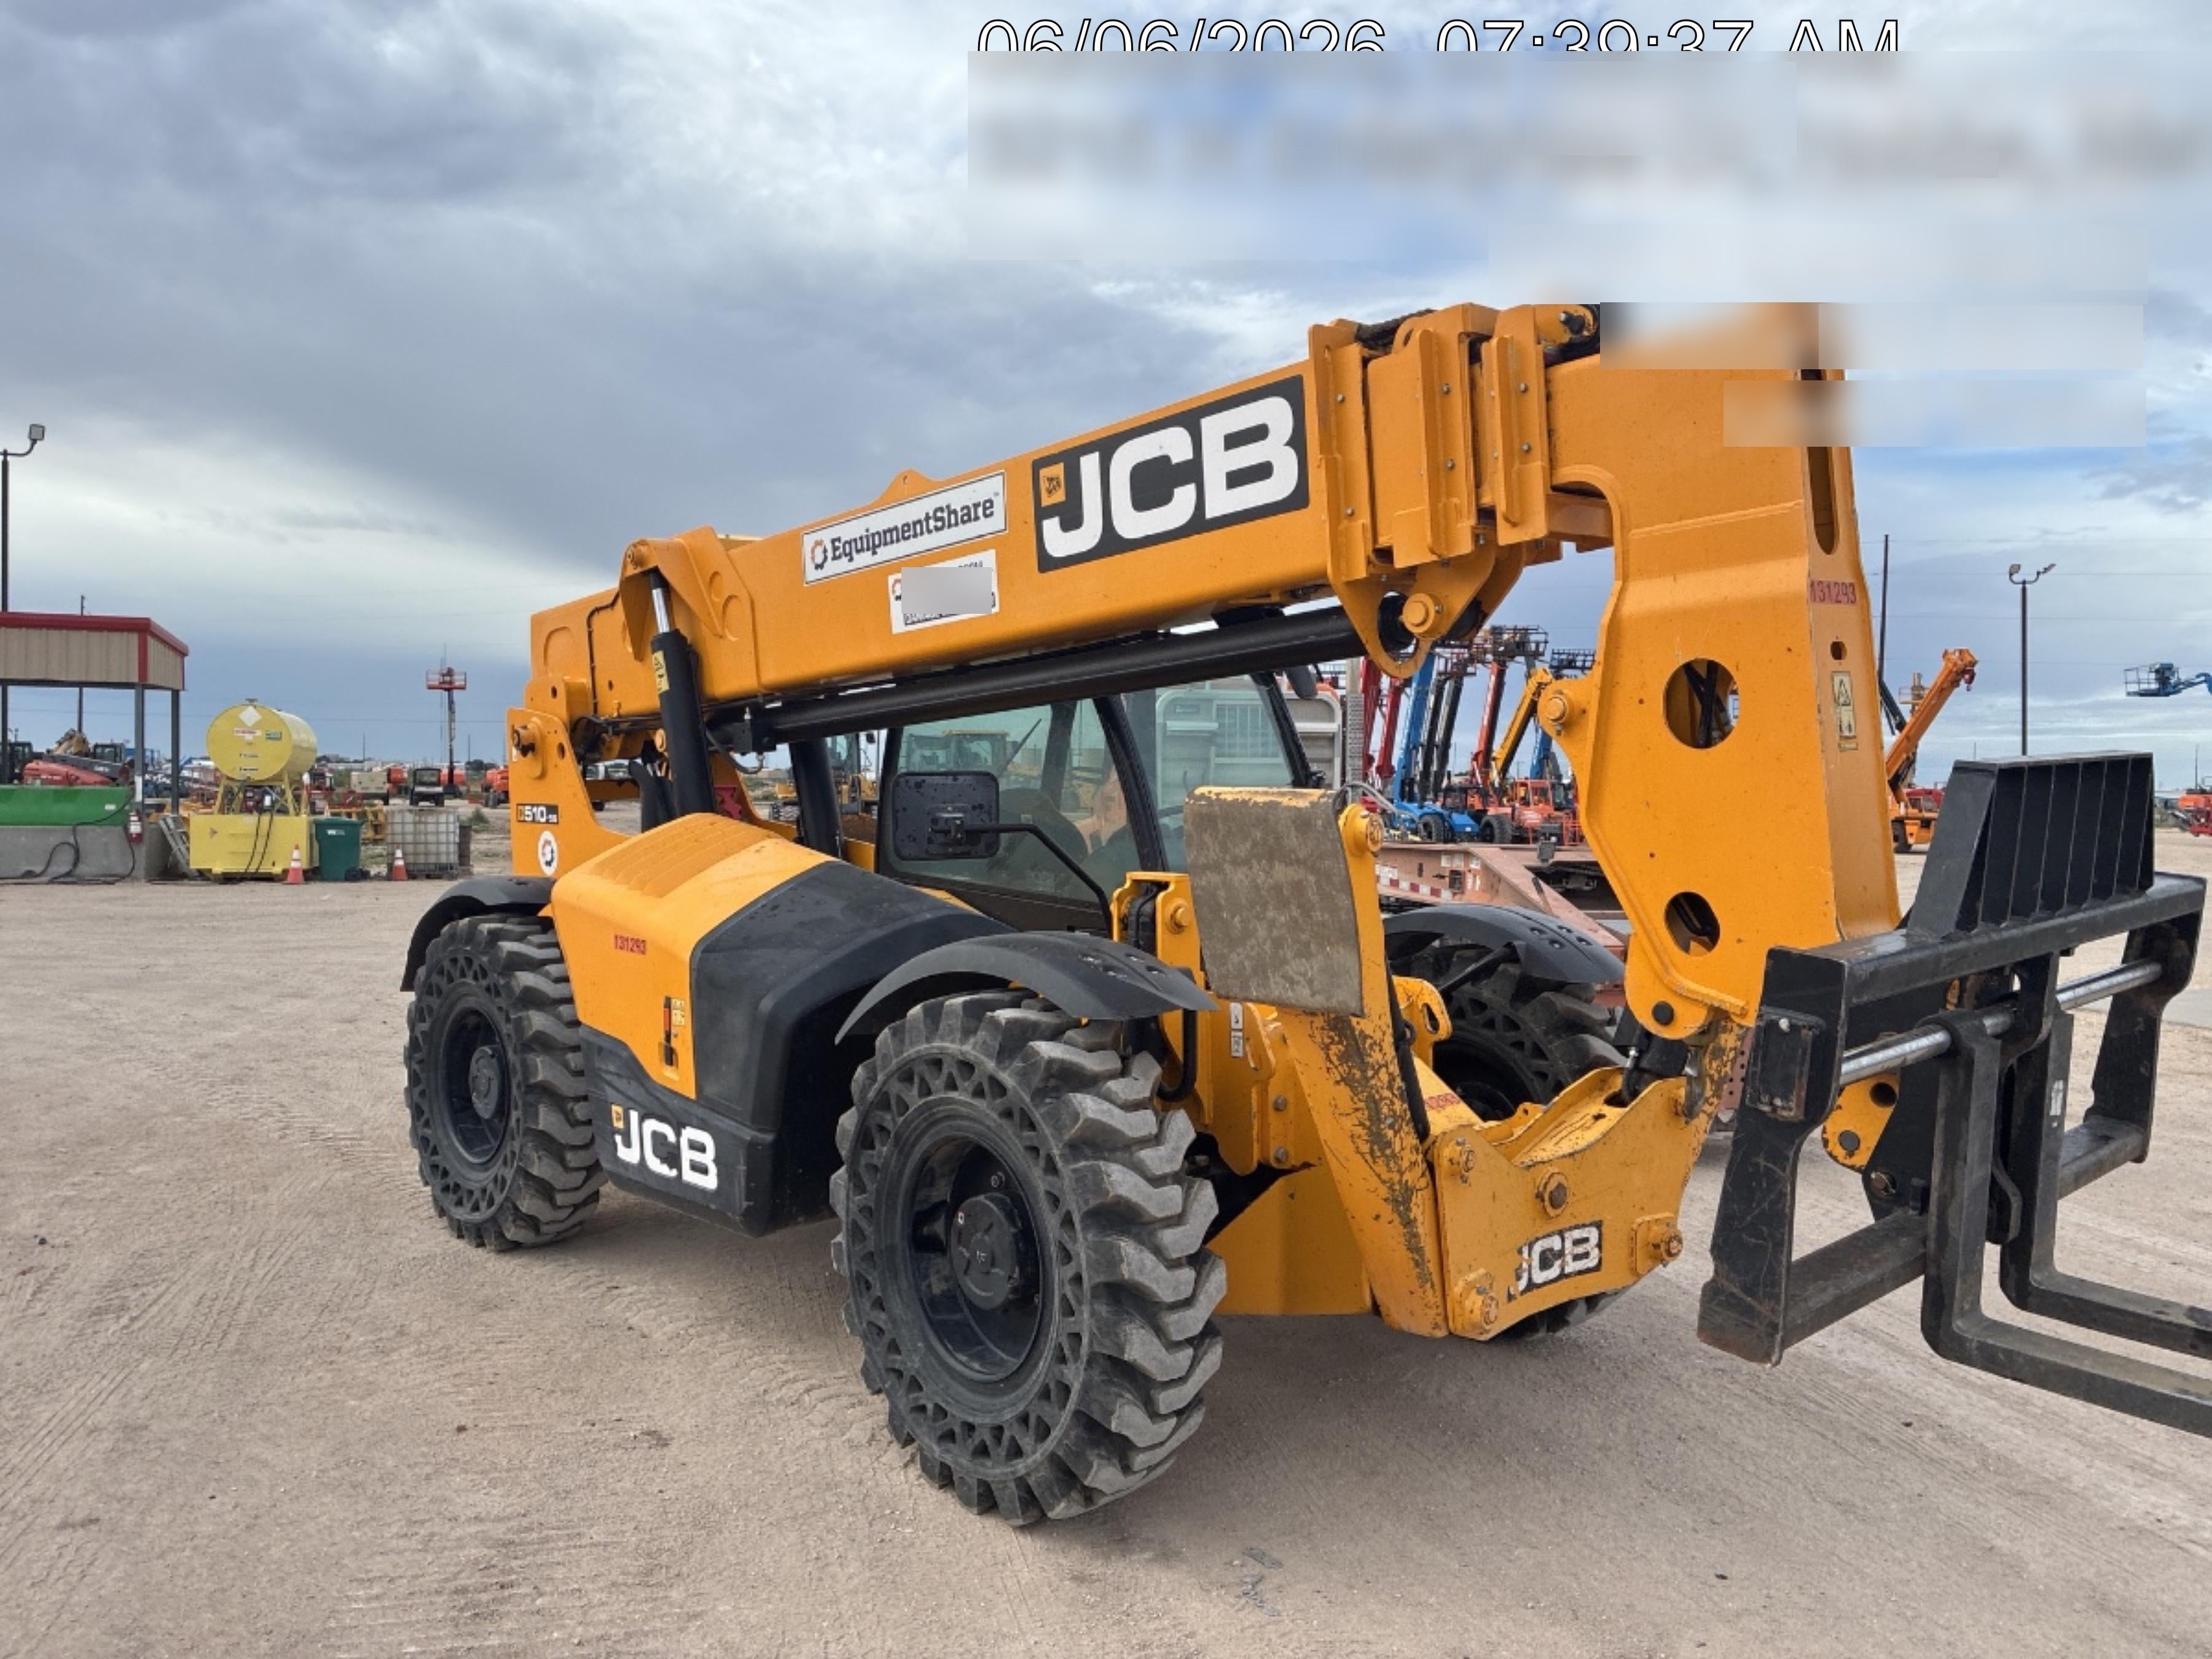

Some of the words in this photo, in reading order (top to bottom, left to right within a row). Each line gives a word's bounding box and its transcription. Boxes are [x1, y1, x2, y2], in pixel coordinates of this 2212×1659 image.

[1042, 396, 1298, 557] JCB
[830, 497, 995, 562] EquipmentShare
[1810, 580, 1857, 604] 131293
[614, 1109, 718, 1190] JCB
